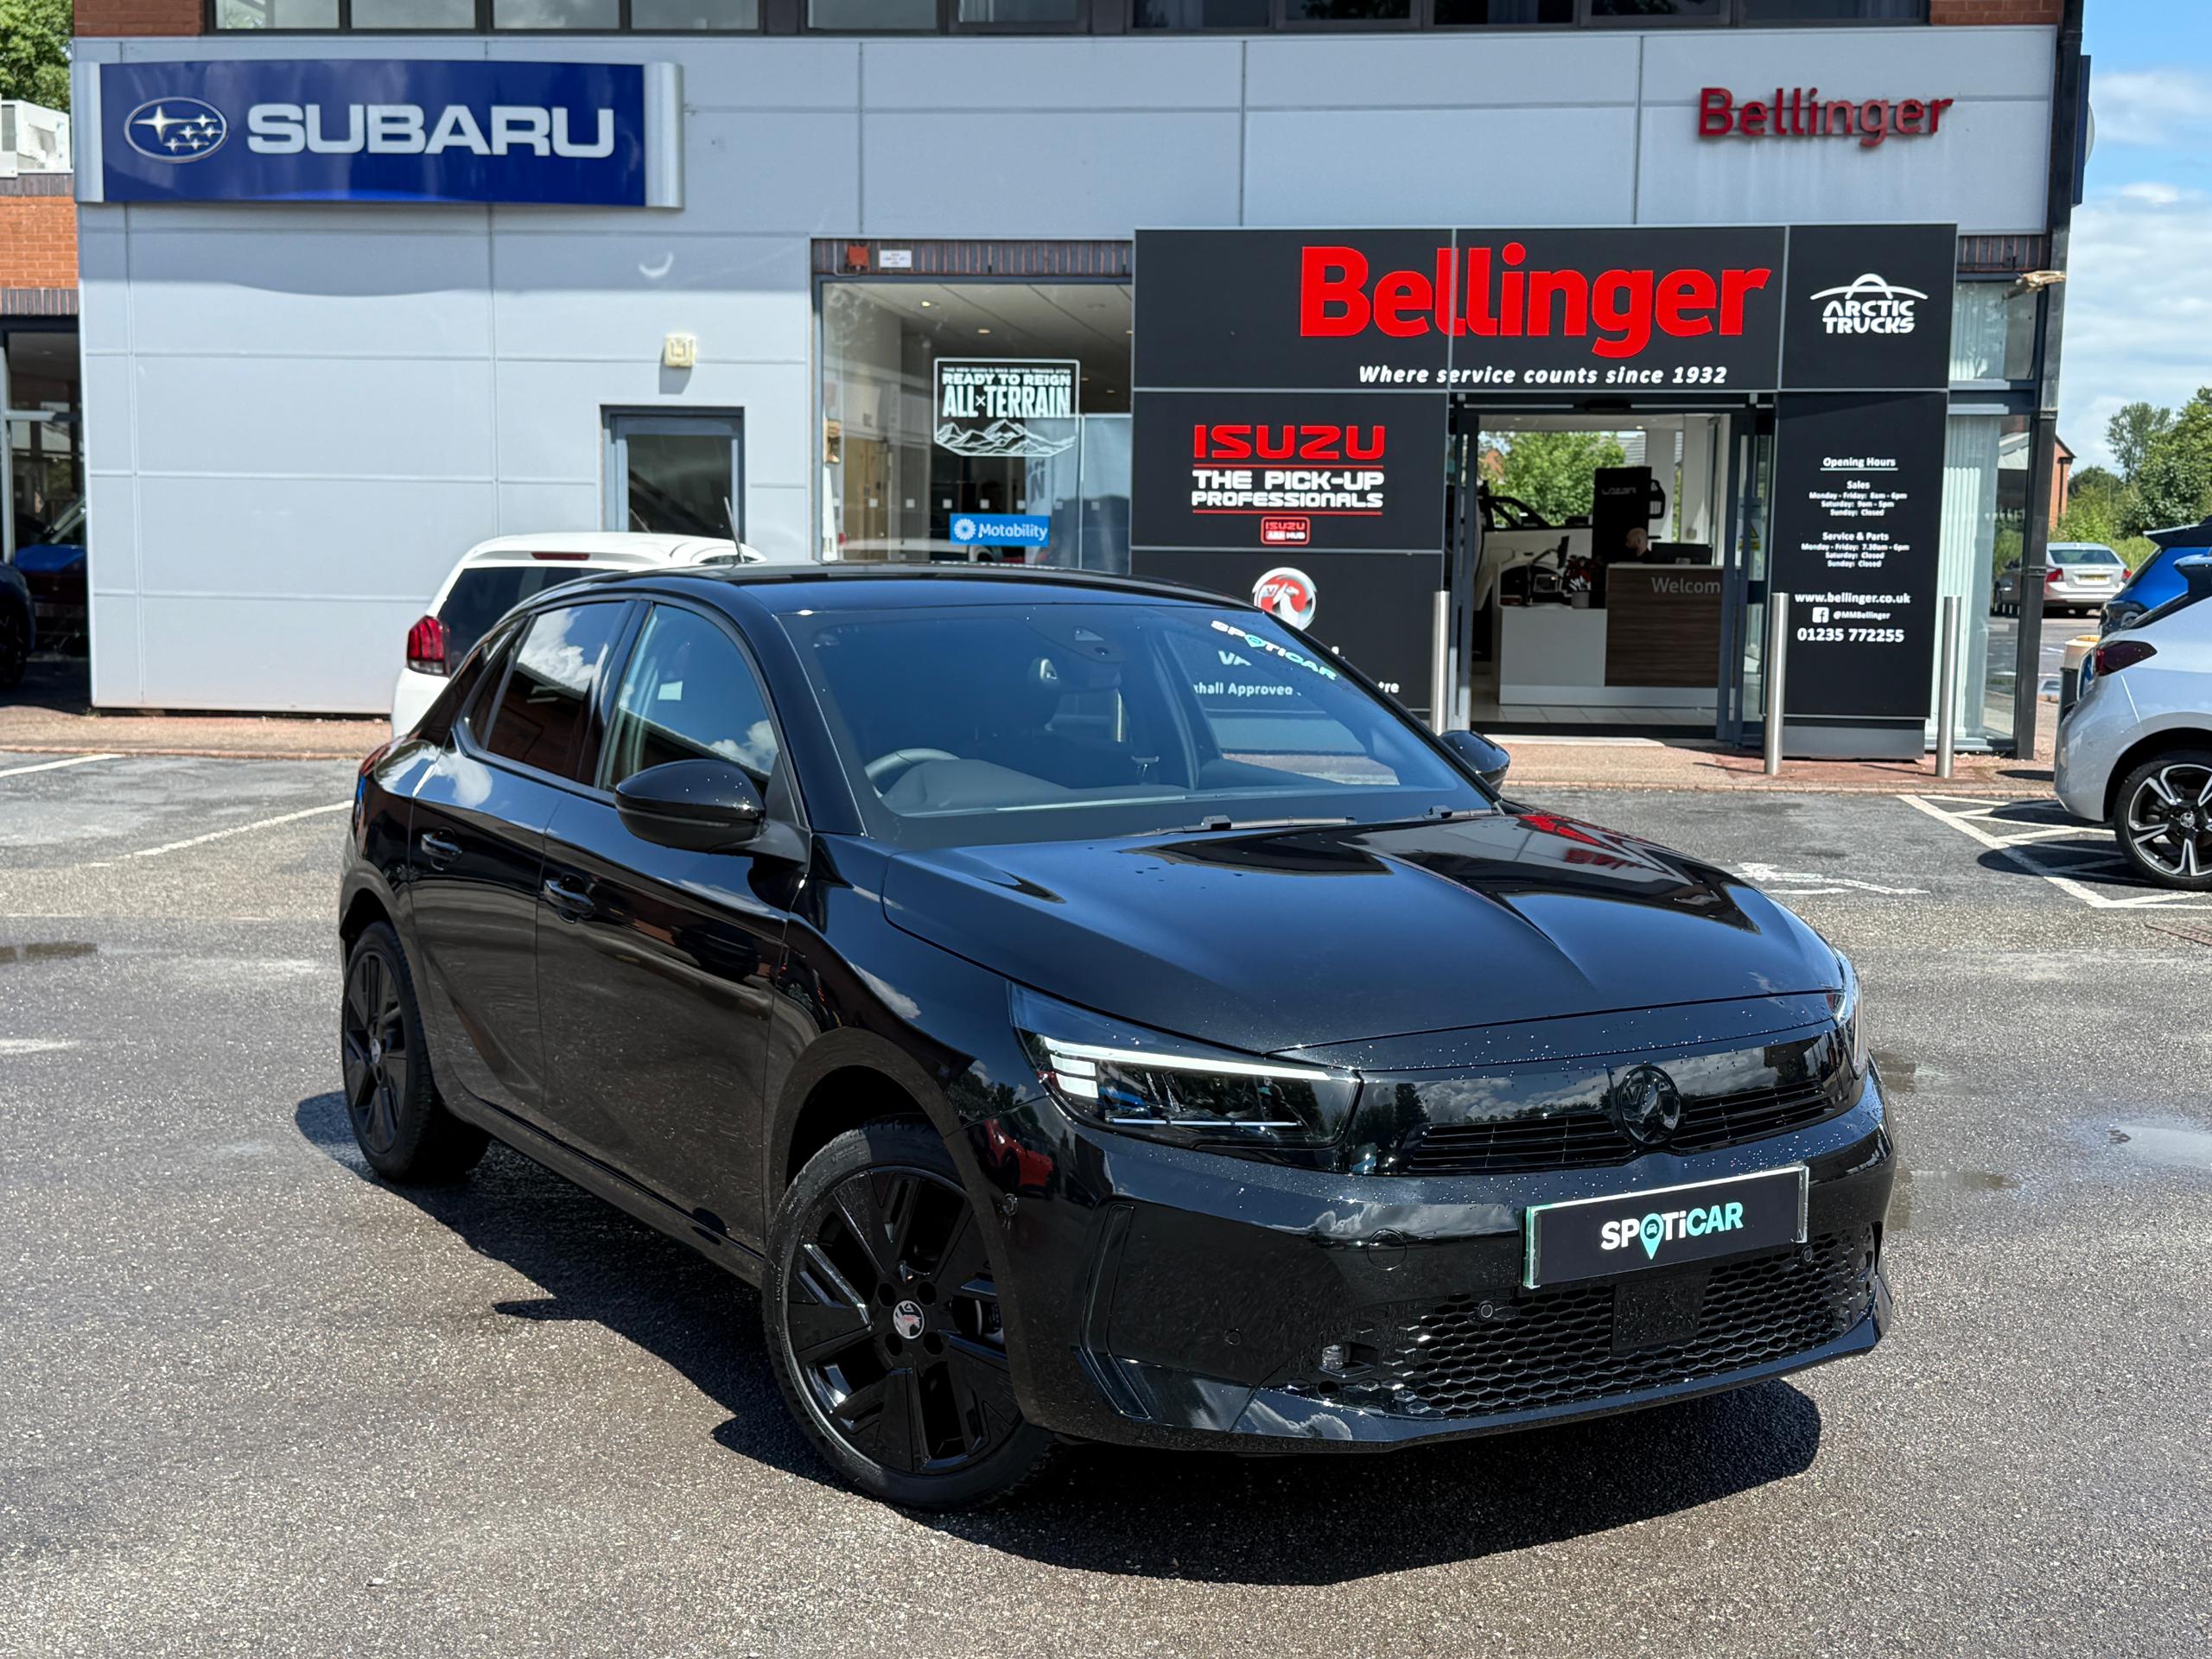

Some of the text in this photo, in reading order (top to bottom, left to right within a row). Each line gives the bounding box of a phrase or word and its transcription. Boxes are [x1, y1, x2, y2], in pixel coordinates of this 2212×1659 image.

[1699, 87, 1955, 147] Bellinger
[247, 104, 614, 158] SUBARU
[1300, 242, 1771, 358] Bellinger
[1822, 300, 1915, 317] ARCTIC
[1821, 317, 1916, 334] TRUCKS
[942, 373, 1071, 386] READY TO REIGN
[1358, 365, 1727, 385] Where service counts since 1932
[942, 385, 979, 417] ALL
[983, 385, 1071, 418] TERRAIN
[1193, 424, 1386, 460] ISUZU
[1822, 456, 1897, 467] Opening Hours
[1192, 469, 1385, 491] THE PICK-UP
[1847, 480, 1871, 489] Sales
[1192, 491, 1384, 508] PROFESSIONALS
[978, 523, 1048, 542] Motability
[1266, 522, 1306, 531] ISUZU
[1822, 531, 1890, 541] Service & Parts
[1801, 543, 1829, 551] Monday
[1651, 577, 1721, 594] Welcom
[1795, 591, 1911, 605] www.bellinger.co.uk
[1833, 611, 1891, 620] @MMBellinger
[1797, 627, 1904, 643] 01235 772255
